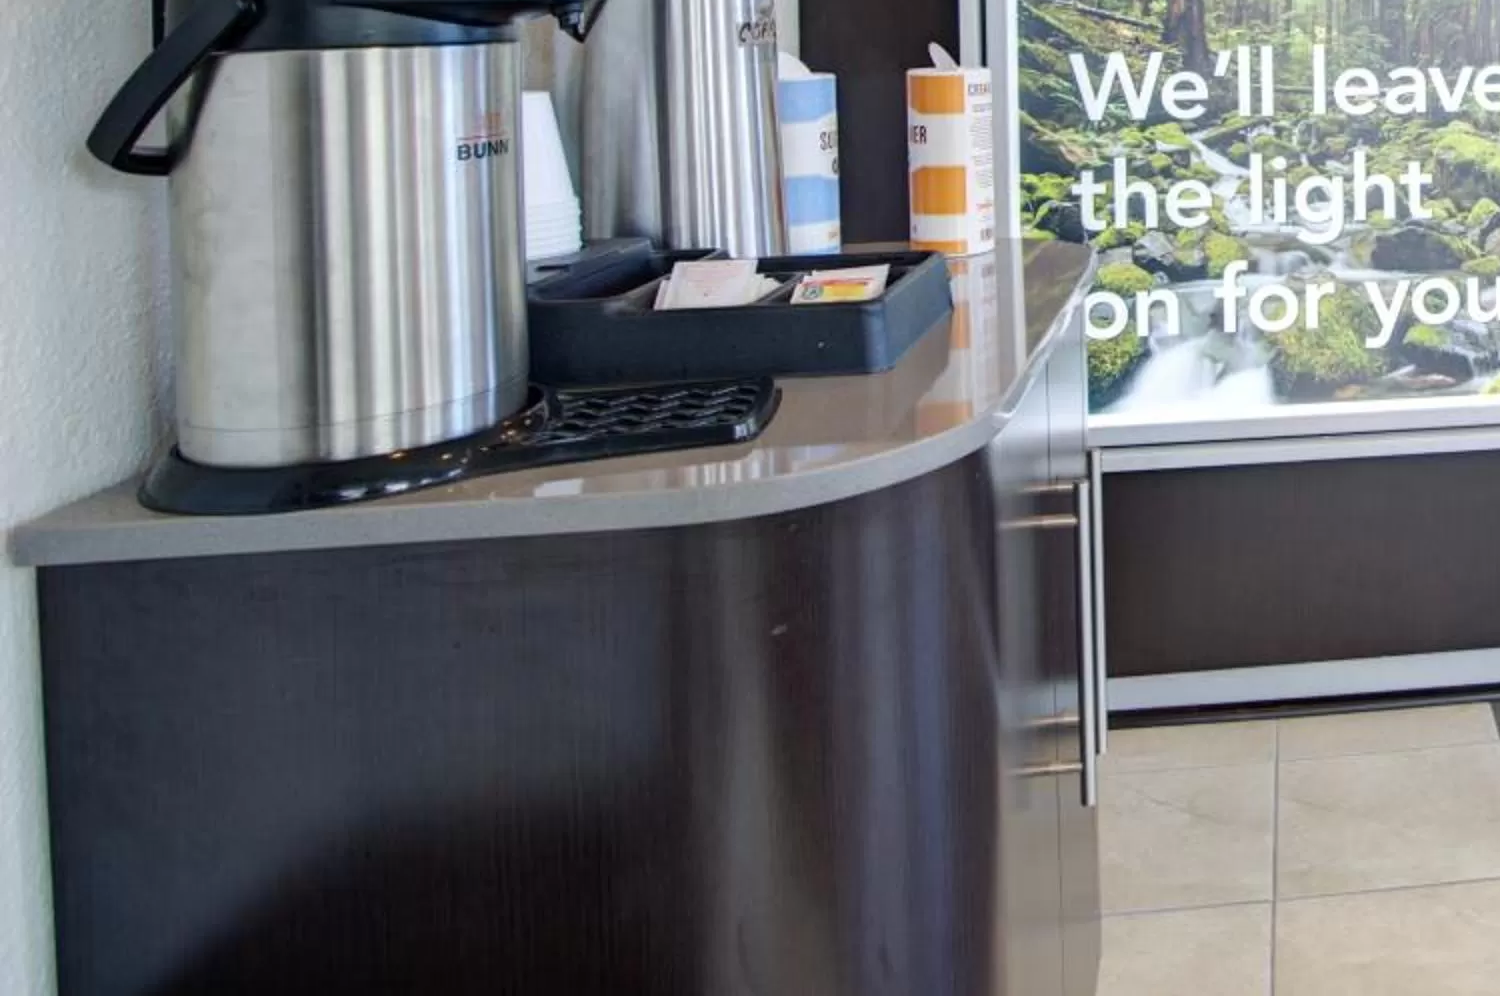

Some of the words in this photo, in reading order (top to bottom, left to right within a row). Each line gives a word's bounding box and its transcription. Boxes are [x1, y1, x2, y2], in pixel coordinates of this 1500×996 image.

[1068, 44, 1275, 122] We'll
[456, 139, 510, 161] BUNN
[1071, 155, 1213, 233] the
[1250, 149, 1434, 245] light
[1084, 285, 1181, 341] on
[1214, 259, 1336, 335] for
